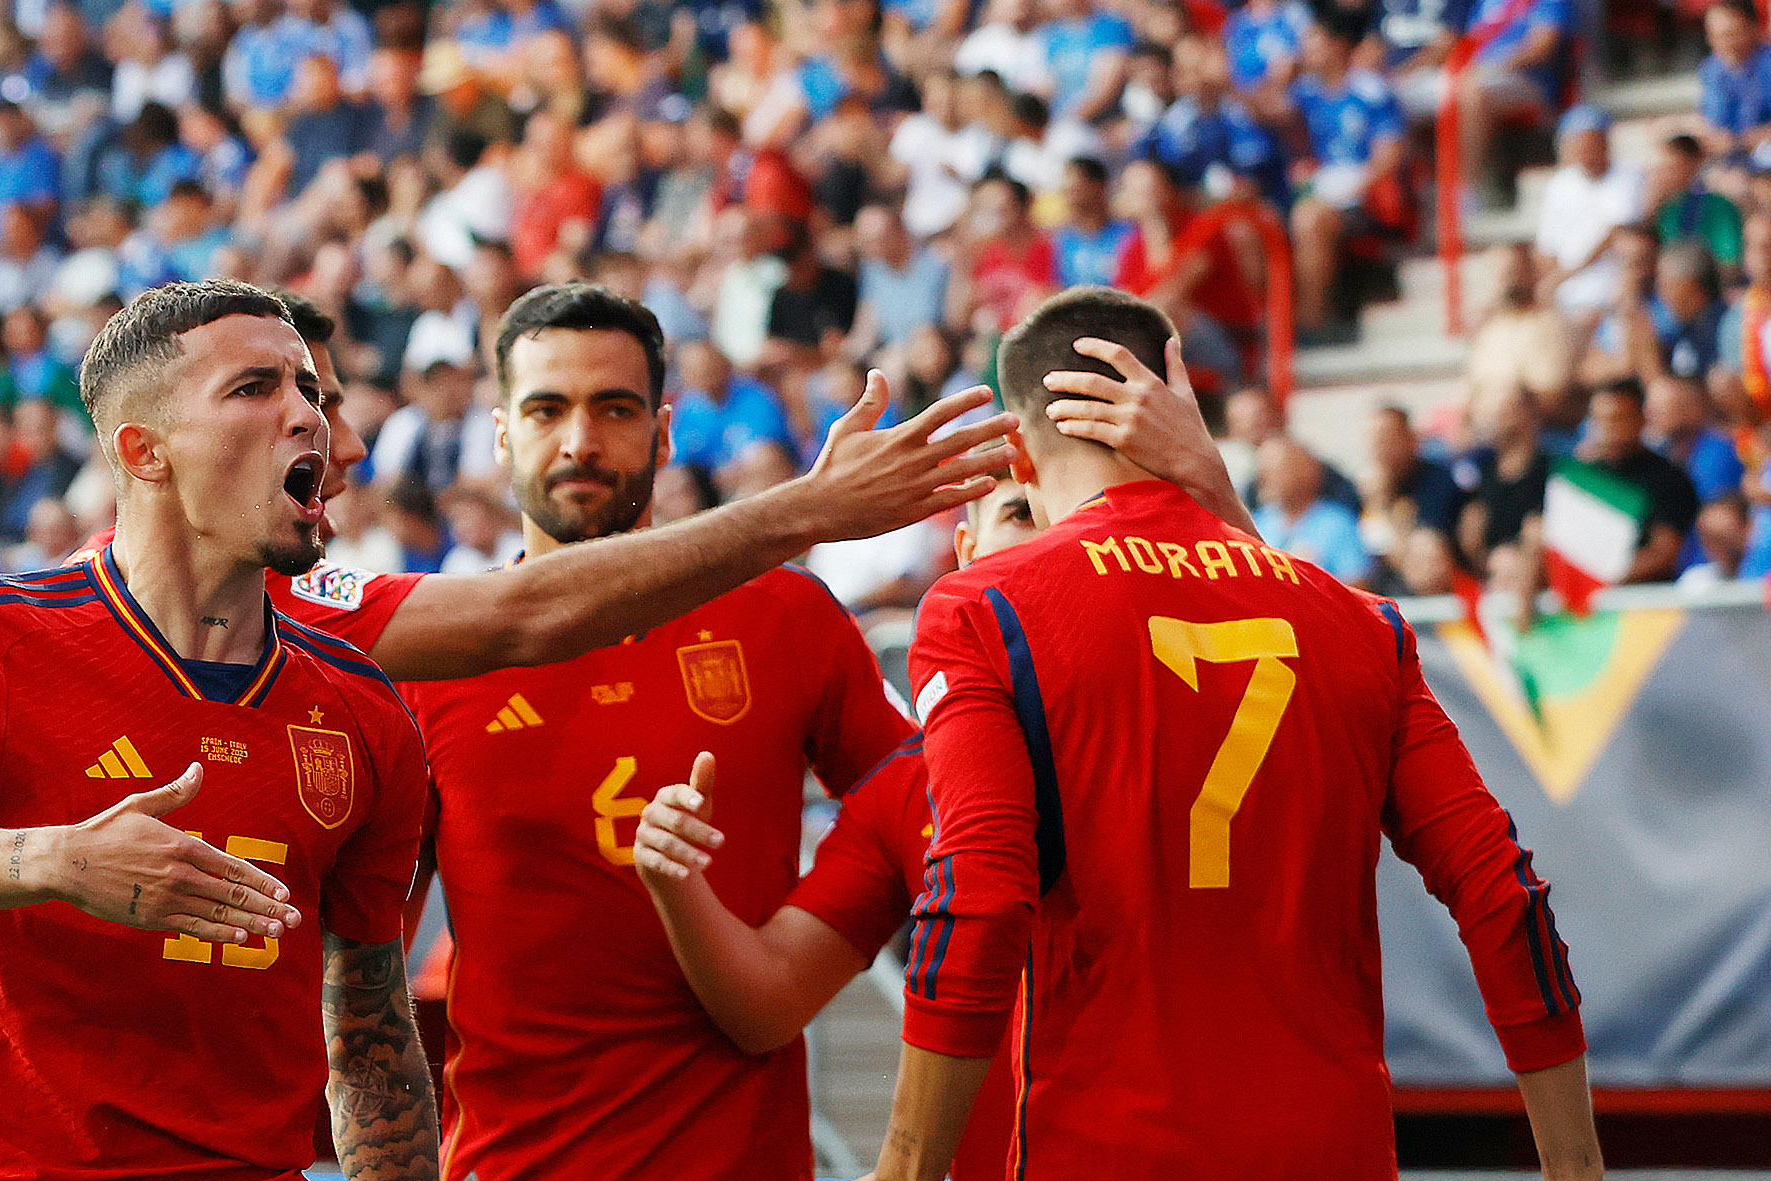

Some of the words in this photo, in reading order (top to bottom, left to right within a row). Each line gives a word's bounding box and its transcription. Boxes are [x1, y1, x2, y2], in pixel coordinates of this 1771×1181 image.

[1080, 536, 1300, 585] MORATA
[201, 736, 222, 746] SPAIN
[230, 740, 248, 750] ITALY
[201, 745, 209, 753] 15
[211, 746, 229, 755] JUNE
[231, 748, 248, 758] 2023
[1147, 615, 1300, 889] 7
[592, 756, 650, 866] 6
